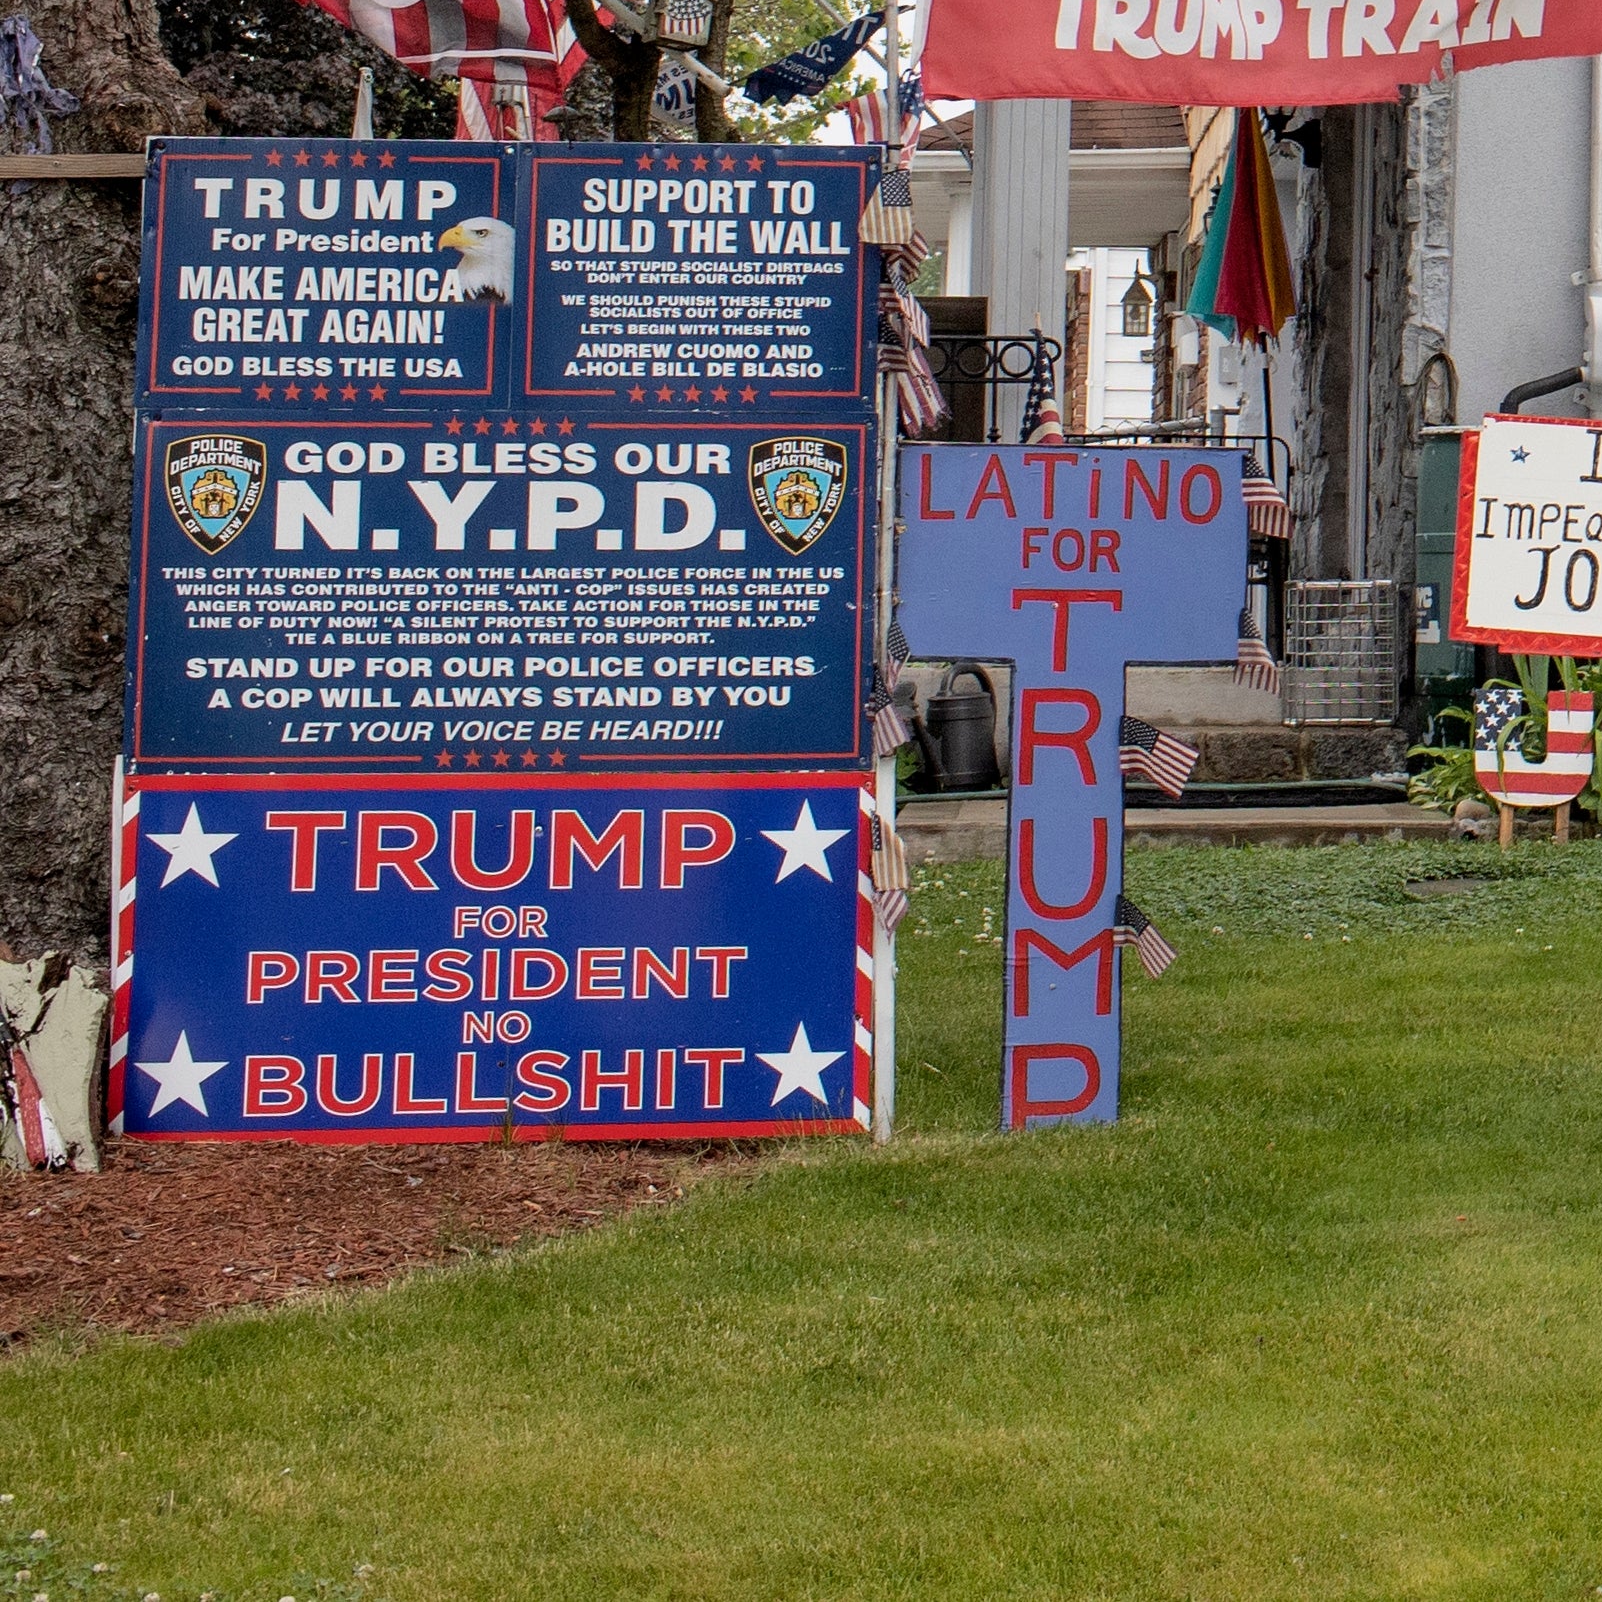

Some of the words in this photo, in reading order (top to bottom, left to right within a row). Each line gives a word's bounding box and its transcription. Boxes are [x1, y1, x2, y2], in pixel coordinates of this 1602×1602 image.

[194, 177, 457, 221] TRUMP
[583, 177, 757, 214] SUPPORT
[767, 180, 814, 215] TO
[212, 227, 266, 252] For
[275, 228, 434, 253] President
[546, 218, 655, 254] BUILD
[667, 219, 738, 254] THE
[749, 220, 851, 255] WALL
[178, 265, 284, 301] MAKE
[294, 266, 464, 303] AMERICA
[192, 307, 310, 343] GREAT
[318, 308, 445, 344] AGAIN!
[172, 355, 234, 376] GOD
[242, 356, 333, 377] BLESS
[338, 357, 396, 378] THE
[404, 357, 463, 378] USA
[575, 343, 672, 359] ANDREW
[677, 343, 760, 360] CUOMO
[765, 344, 813, 360] AND
[563, 361, 646, 377] A-HOLE
[652, 362, 701, 377] BILL
[706, 362, 736, 377] DE
[742, 362, 823, 378] BLASIO
[170, 453, 262, 475] DEPARTMENT
[191, 439, 243, 454] POLICE
[284, 441, 405, 474] GOD
[424, 442, 597, 475] BLESS
[614, 442, 731, 475] OUR
[171, 485, 190, 515] CITY
[185, 519, 201, 533] OF
[219, 517, 242, 542] NEW
[239, 481, 261, 513] YORK
[274, 479, 746, 551] N.Y.P.D.
[1021, 527, 1122, 574] FOR
[161, 567, 207, 580] THIS
[212, 567, 258, 580] CITY
[261, 567, 341, 580] TURNED
[388, 567, 440, 580] BACK
[445, 567, 473, 580] ON
[477, 567, 515, 580] THE
[520, 567, 607, 580] LARGEST
[611, 567, 679, 580] POLICE
[684, 567, 747, 580] FORCE
[752, 567, 772, 580] IN
[775, 567, 814, 580] THE
[819, 567, 844, 580] US
[185, 657, 299, 679] STAND
[309, 657, 356, 679] UP
[365, 657, 433, 678] FOR
[442, 657, 514, 678] OUR
[524, 656, 644, 678] POLICE
[653, 656, 814, 677] OFFICERS
[207, 688, 232, 709] A
[241, 687, 313, 709] COP
[319, 687, 402, 708] WILL
[410, 686, 543, 708] ALWAYS
[552, 686, 662, 708] STAND
[671, 686, 717, 707] BY
[722, 686, 791, 707] YOU
[280, 722, 342, 743] LET
[349, 721, 434, 743] YOUR
[444, 720, 535, 742] VOICE
[540, 720, 584, 741] BE
[588, 720, 724, 741] HEARD!!!
[265, 809, 736, 892] TRUMP
[1010, 588, 1123, 1131] TRUMP
[453, 905, 548, 939] FOR
[246, 946, 748, 1004] PRESIDENT
[462, 1010, 532, 1044] NO
[242, 1047, 745, 1118] BULLSHIT
